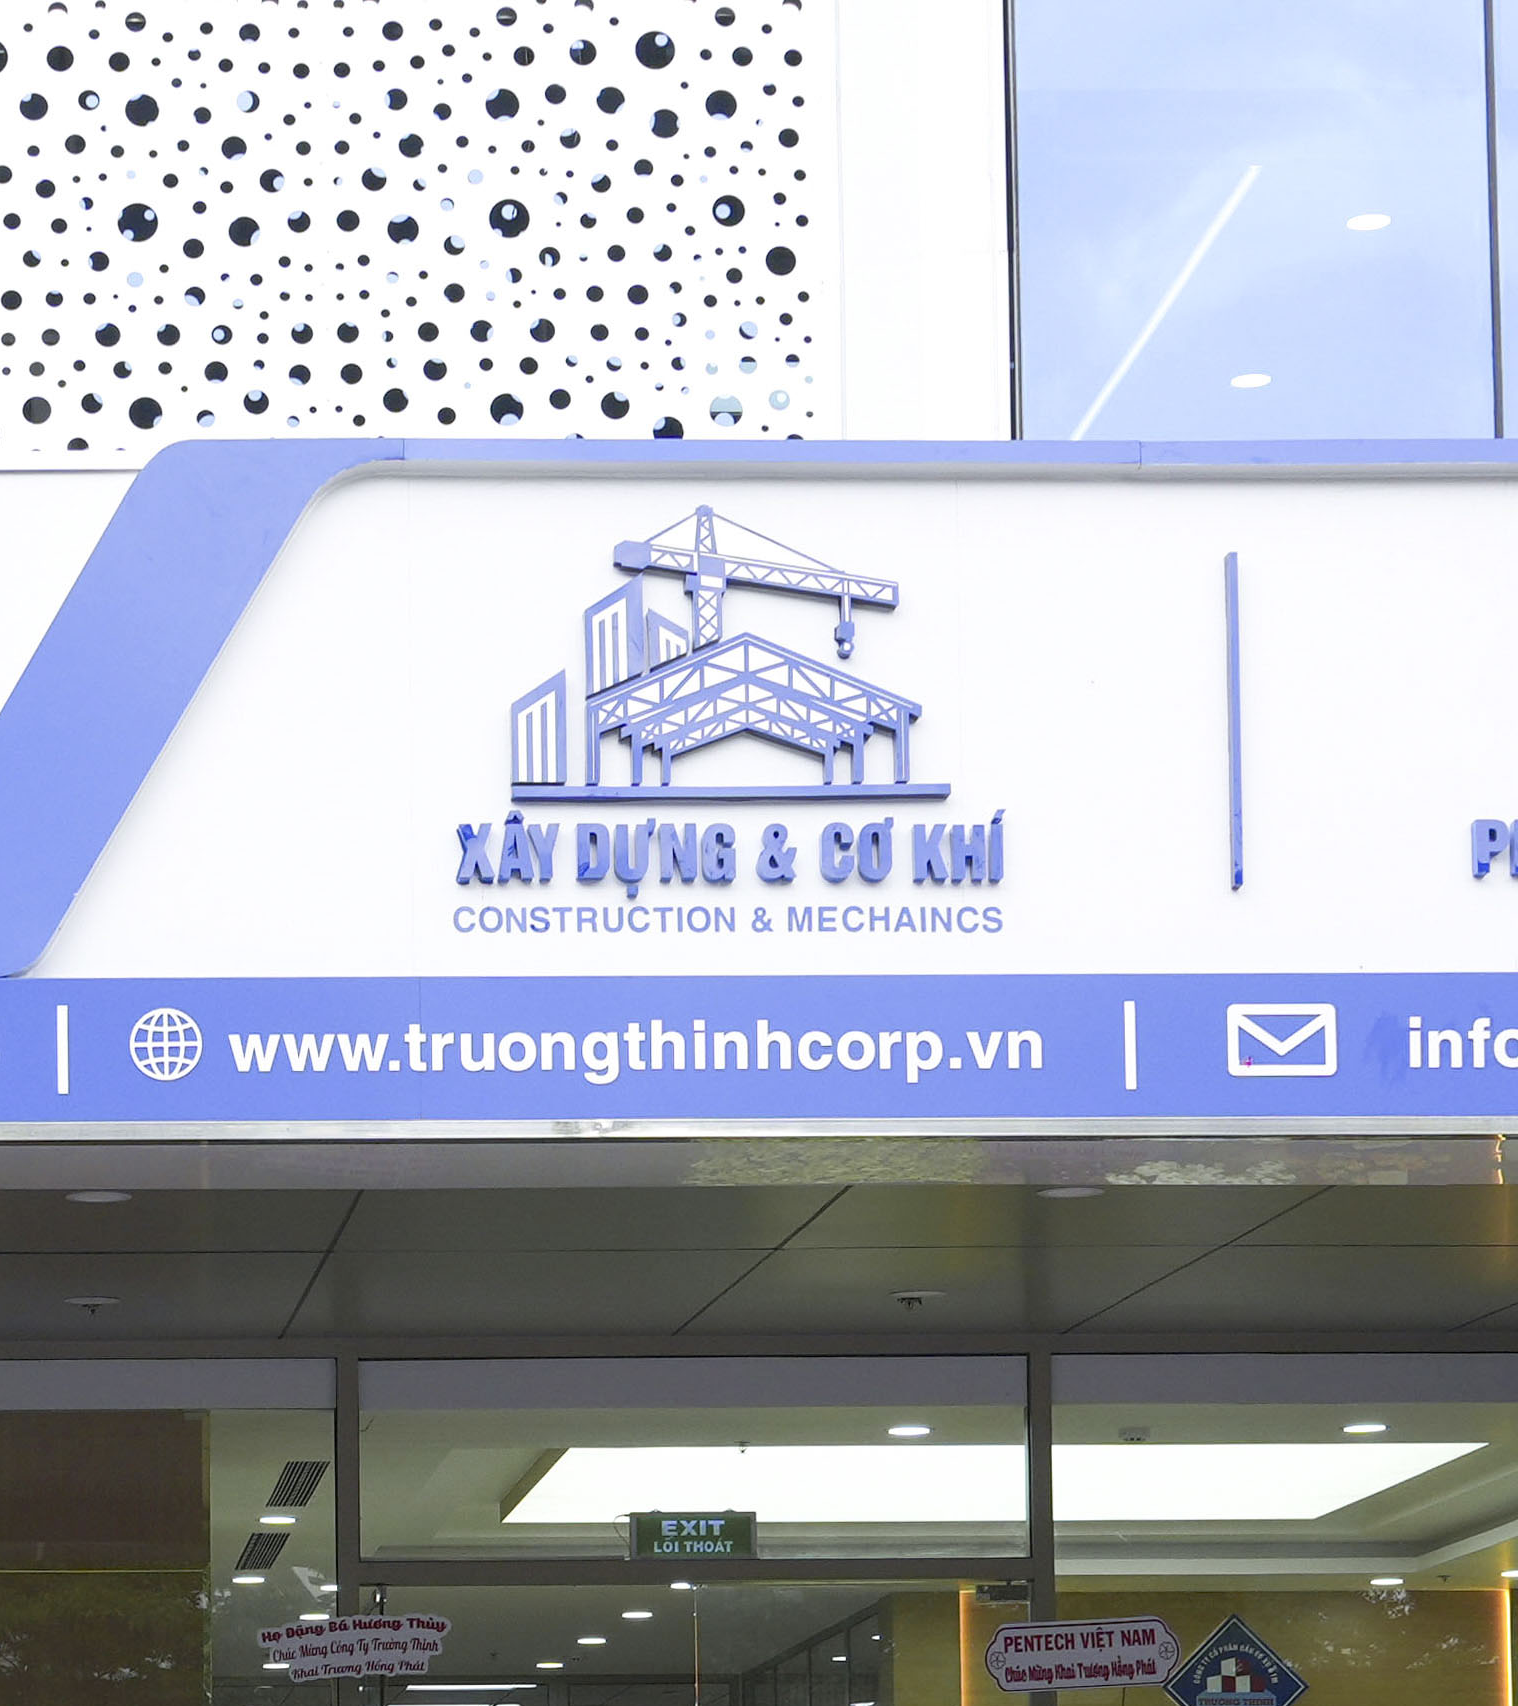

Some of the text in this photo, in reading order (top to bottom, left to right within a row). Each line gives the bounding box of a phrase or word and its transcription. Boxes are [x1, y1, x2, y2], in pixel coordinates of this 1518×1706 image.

[456, 809, 1005, 901] XÂY DỰNG & CƠ KHÍ
[454, 906, 1002, 933] CONSTRUCTION & MECHAINCS
[229, 1020, 1042, 1084] www.truongthinhcorp.vn
[661, 1520, 725, 1536] EXIT
[1004, 1626, 1155, 1653] PENTECH VIỆT NAM
